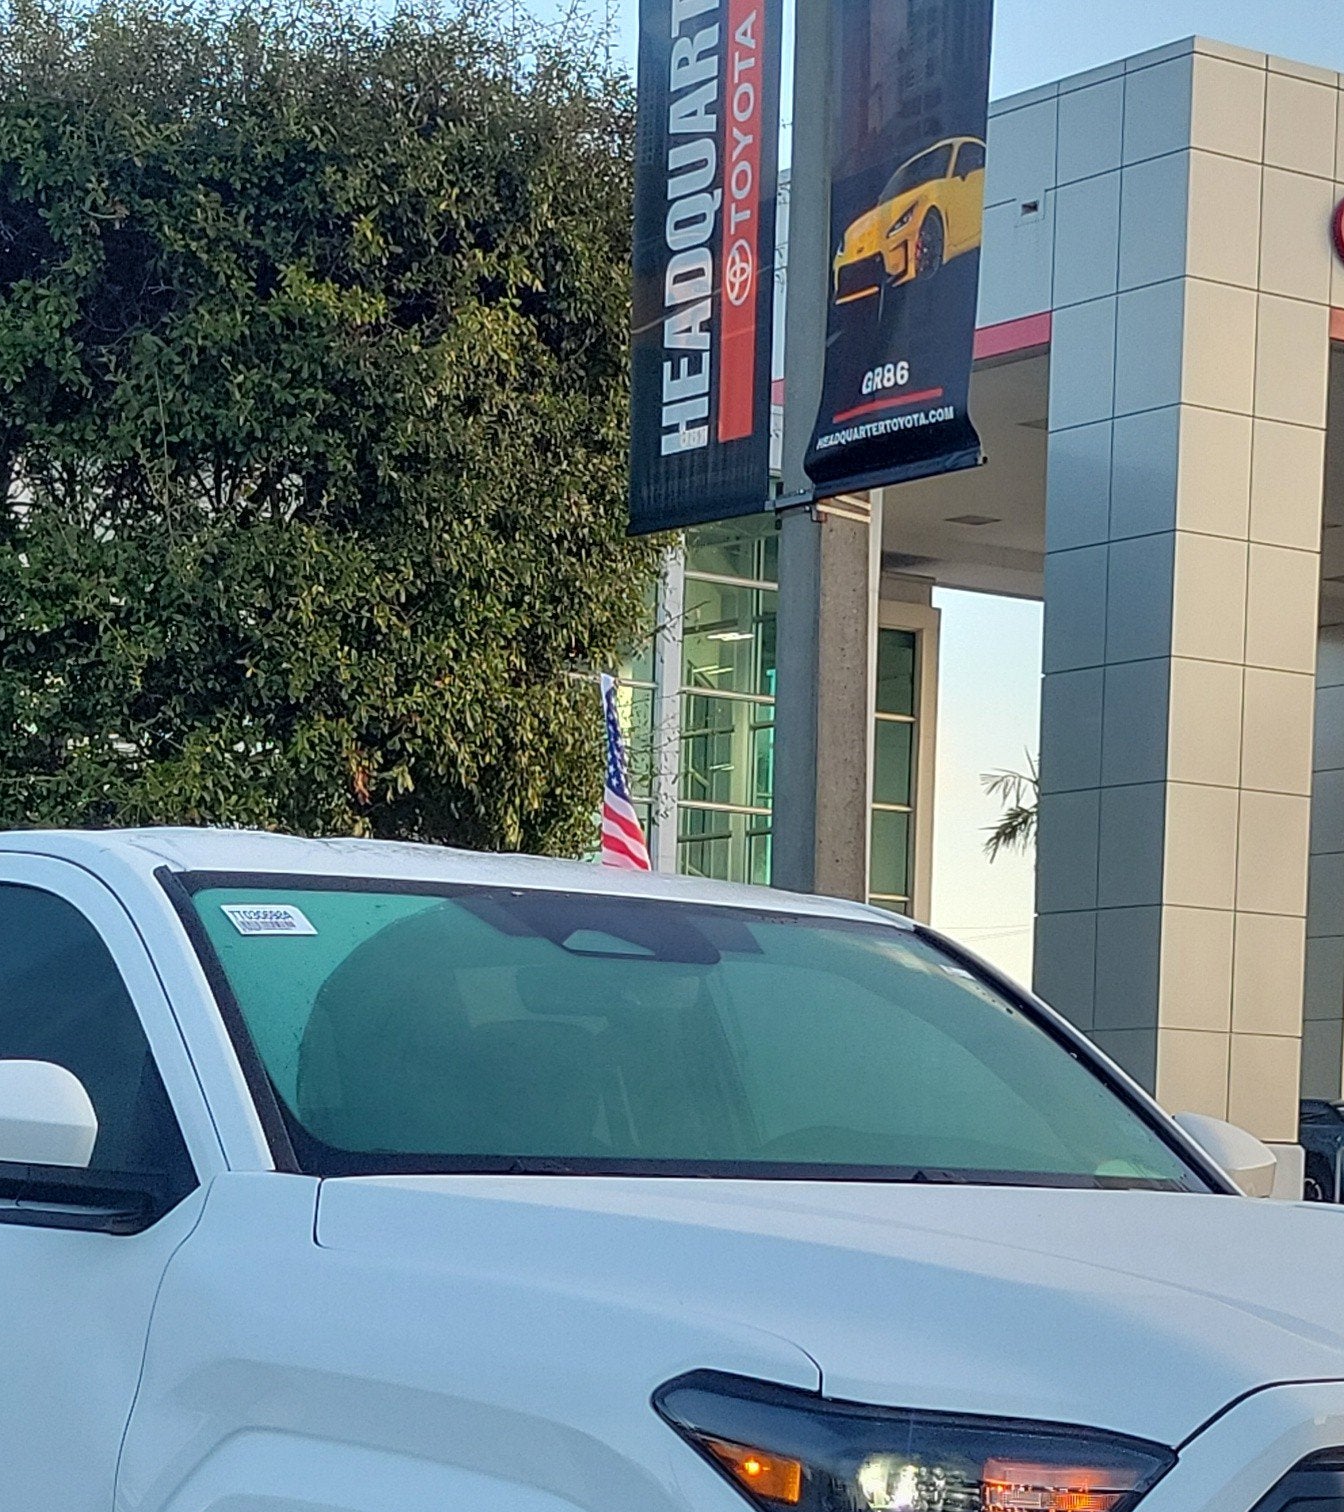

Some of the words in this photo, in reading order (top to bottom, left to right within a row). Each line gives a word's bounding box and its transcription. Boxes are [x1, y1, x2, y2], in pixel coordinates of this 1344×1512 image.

[730, 9, 757, 236] TOYOTA
[861, 361, 910, 395] GR86
[816, 405, 955, 450] HEADQUARTERTOYOTA.COM
